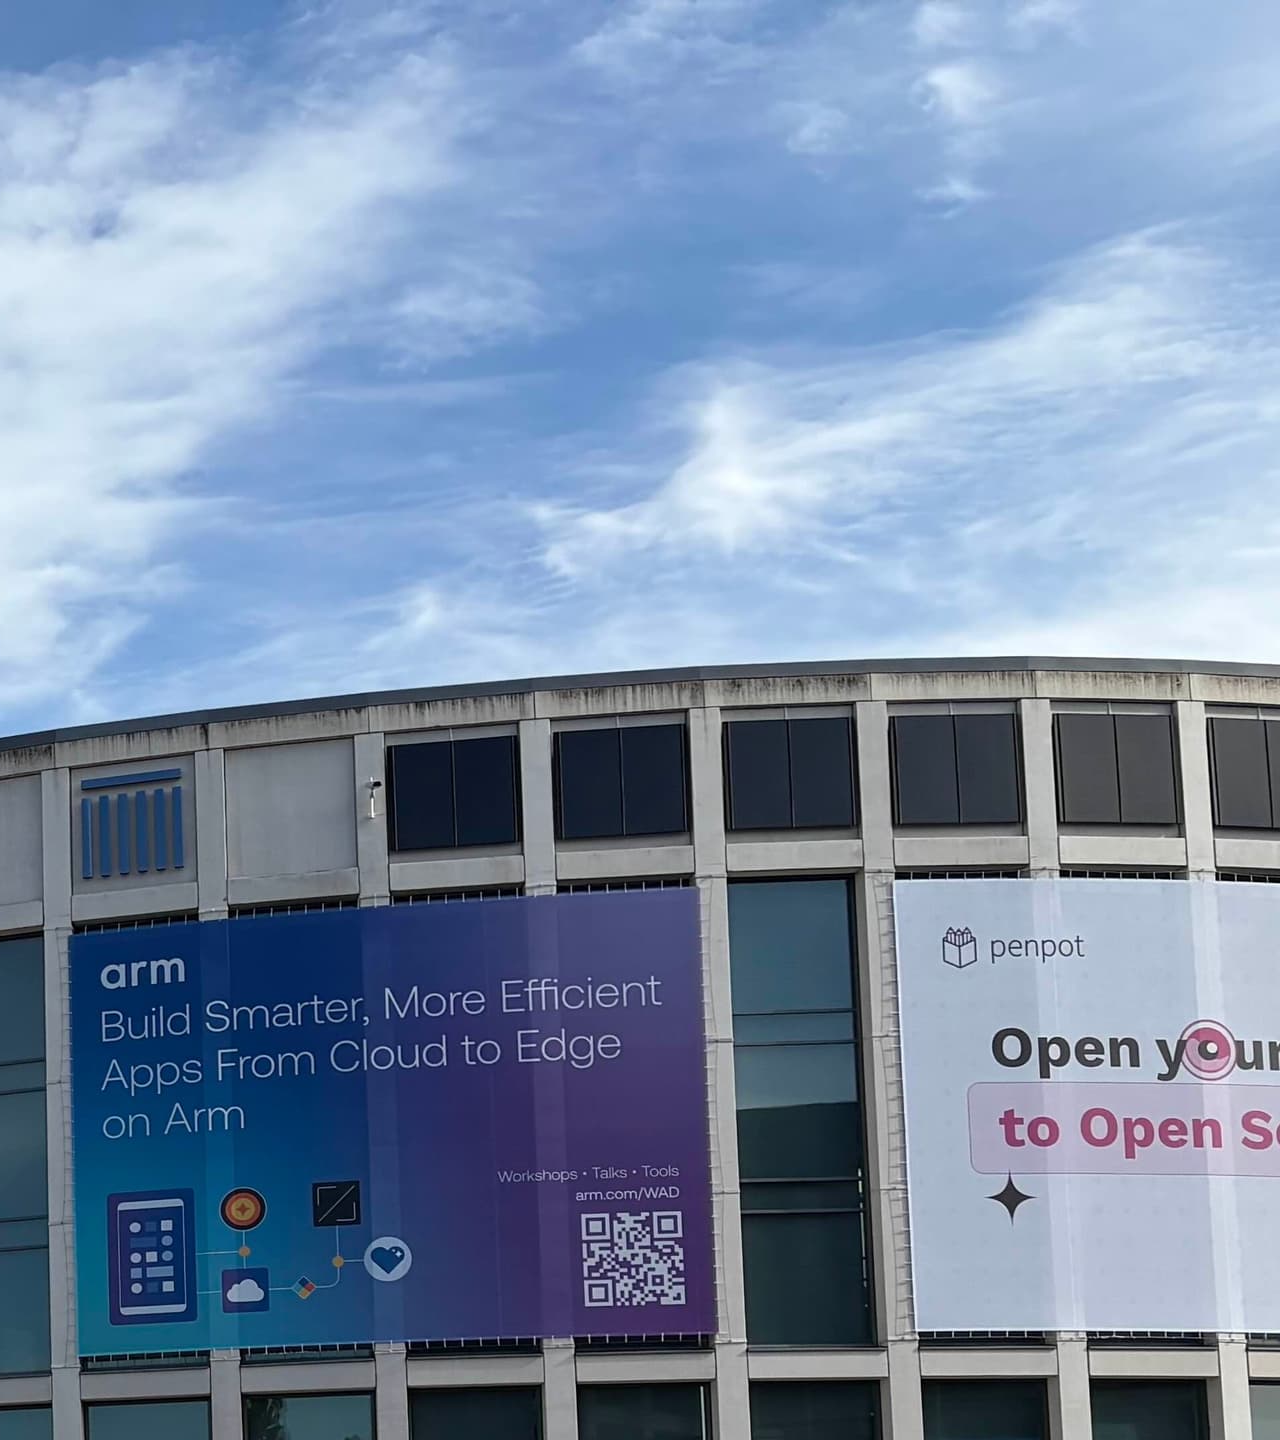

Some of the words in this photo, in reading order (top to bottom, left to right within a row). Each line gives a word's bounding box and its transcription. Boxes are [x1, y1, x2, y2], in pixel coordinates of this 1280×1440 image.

[990, 935, 1086, 964] penpot
[100, 957, 185, 990] arm
[101, 1003, 190, 1042] Build
[205, 995, 370, 1033] Smarter,
[384, 986, 485, 1019] More
[501, 975, 662, 1013] Efficient
[101, 1059, 203, 1097] Apps
[217, 1048, 315, 1081] From
[330, 1034, 448, 1072] Cloud
[460, 1035, 501, 1066] to
[517, 1028, 621, 1069] Edge
[991, 1027, 1141, 1079] Open
[102, 1113, 150, 1139] on
[164, 1102, 245, 1135] Arm
[999, 1108, 1060, 1148] to
[1080, 1107, 1223, 1159] Open
[497, 1169, 578, 1183] Workshops
[592, 1166, 628, 1179] Talks
[641, 1164, 680, 1177] Tools
[576, 1186, 680, 1201] arm.com/WAD
